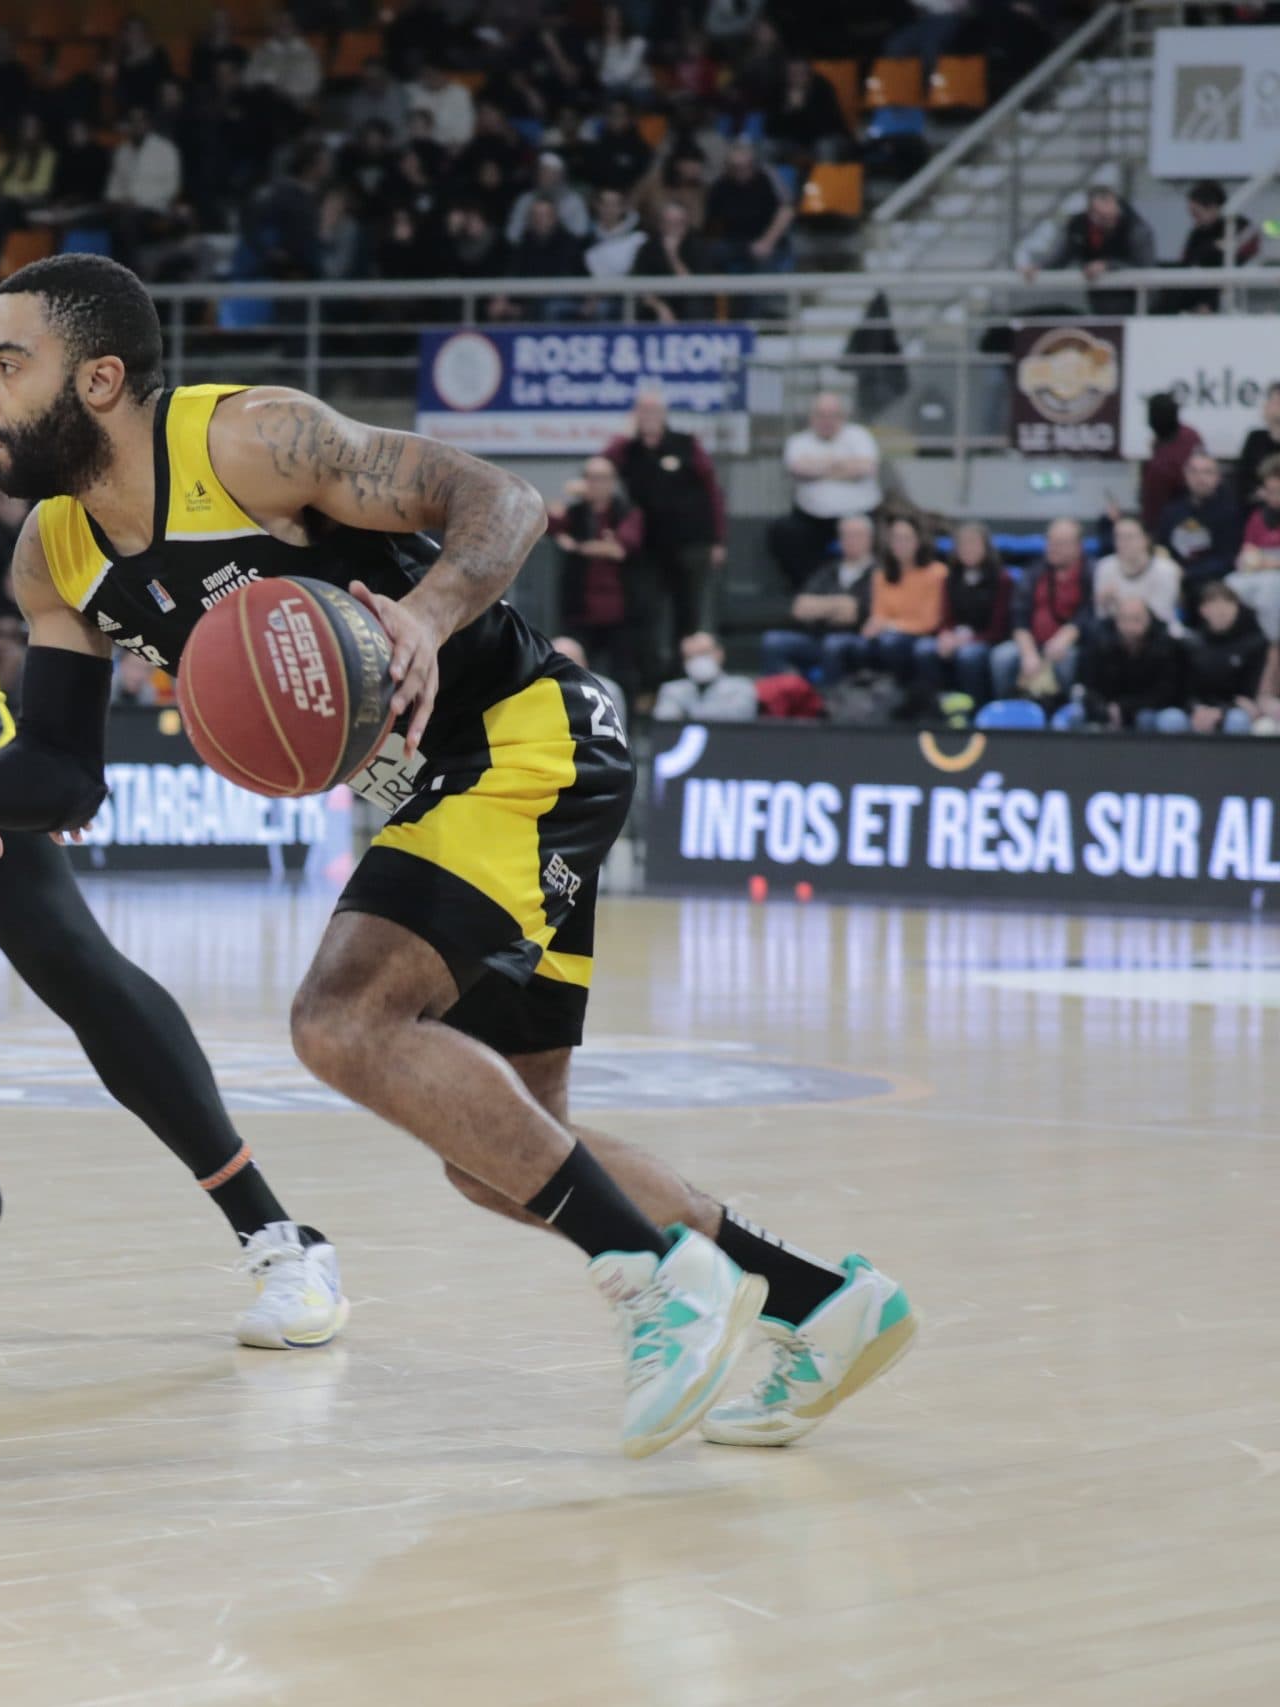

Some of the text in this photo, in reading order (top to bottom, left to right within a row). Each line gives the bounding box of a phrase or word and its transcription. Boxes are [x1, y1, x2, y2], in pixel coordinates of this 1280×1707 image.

[514, 335, 606, 373] ROSE
[610, 334, 640, 372] &
[1158, 366, 1261, 409] ekle
[202, 561, 241, 592] GROUPE
[280, 598, 336, 717] LEGACY
[681, 772, 1280, 882] INFOS ET RÉSA SUR AL
